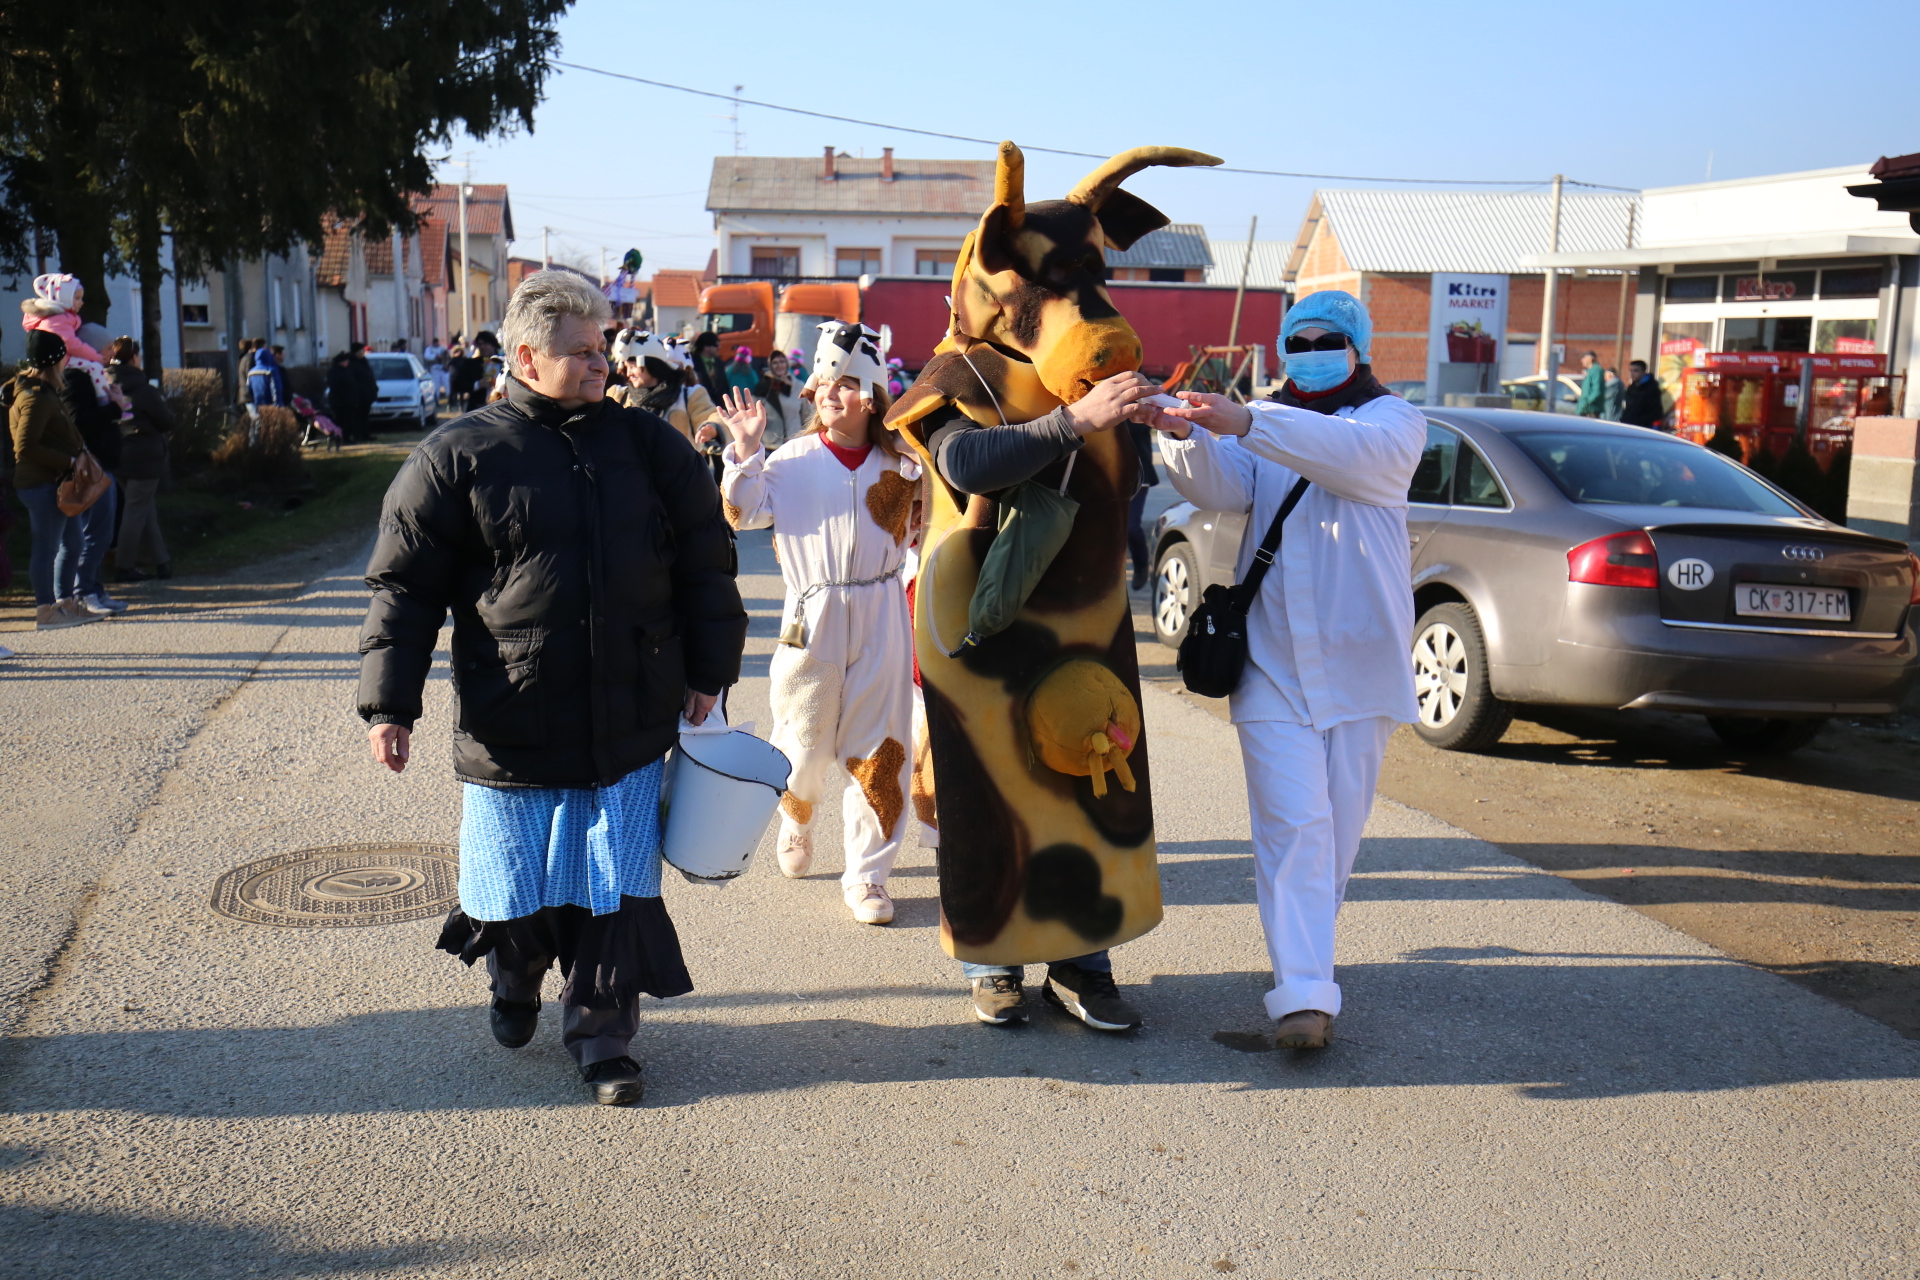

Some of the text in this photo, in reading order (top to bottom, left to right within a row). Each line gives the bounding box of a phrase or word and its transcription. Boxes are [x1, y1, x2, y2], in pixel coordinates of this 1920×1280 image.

[1736, 278, 1797, 300] Kitro
[1449, 299, 1496, 309] MARKET
[1711, 355, 1741, 363] PETROL
[1748, 355, 1780, 363] PETROL
[1840, 359, 1876, 367] PETROL
[1677, 563, 1705, 585] HR
[1749, 588, 1847, 615] CK 317-FM
